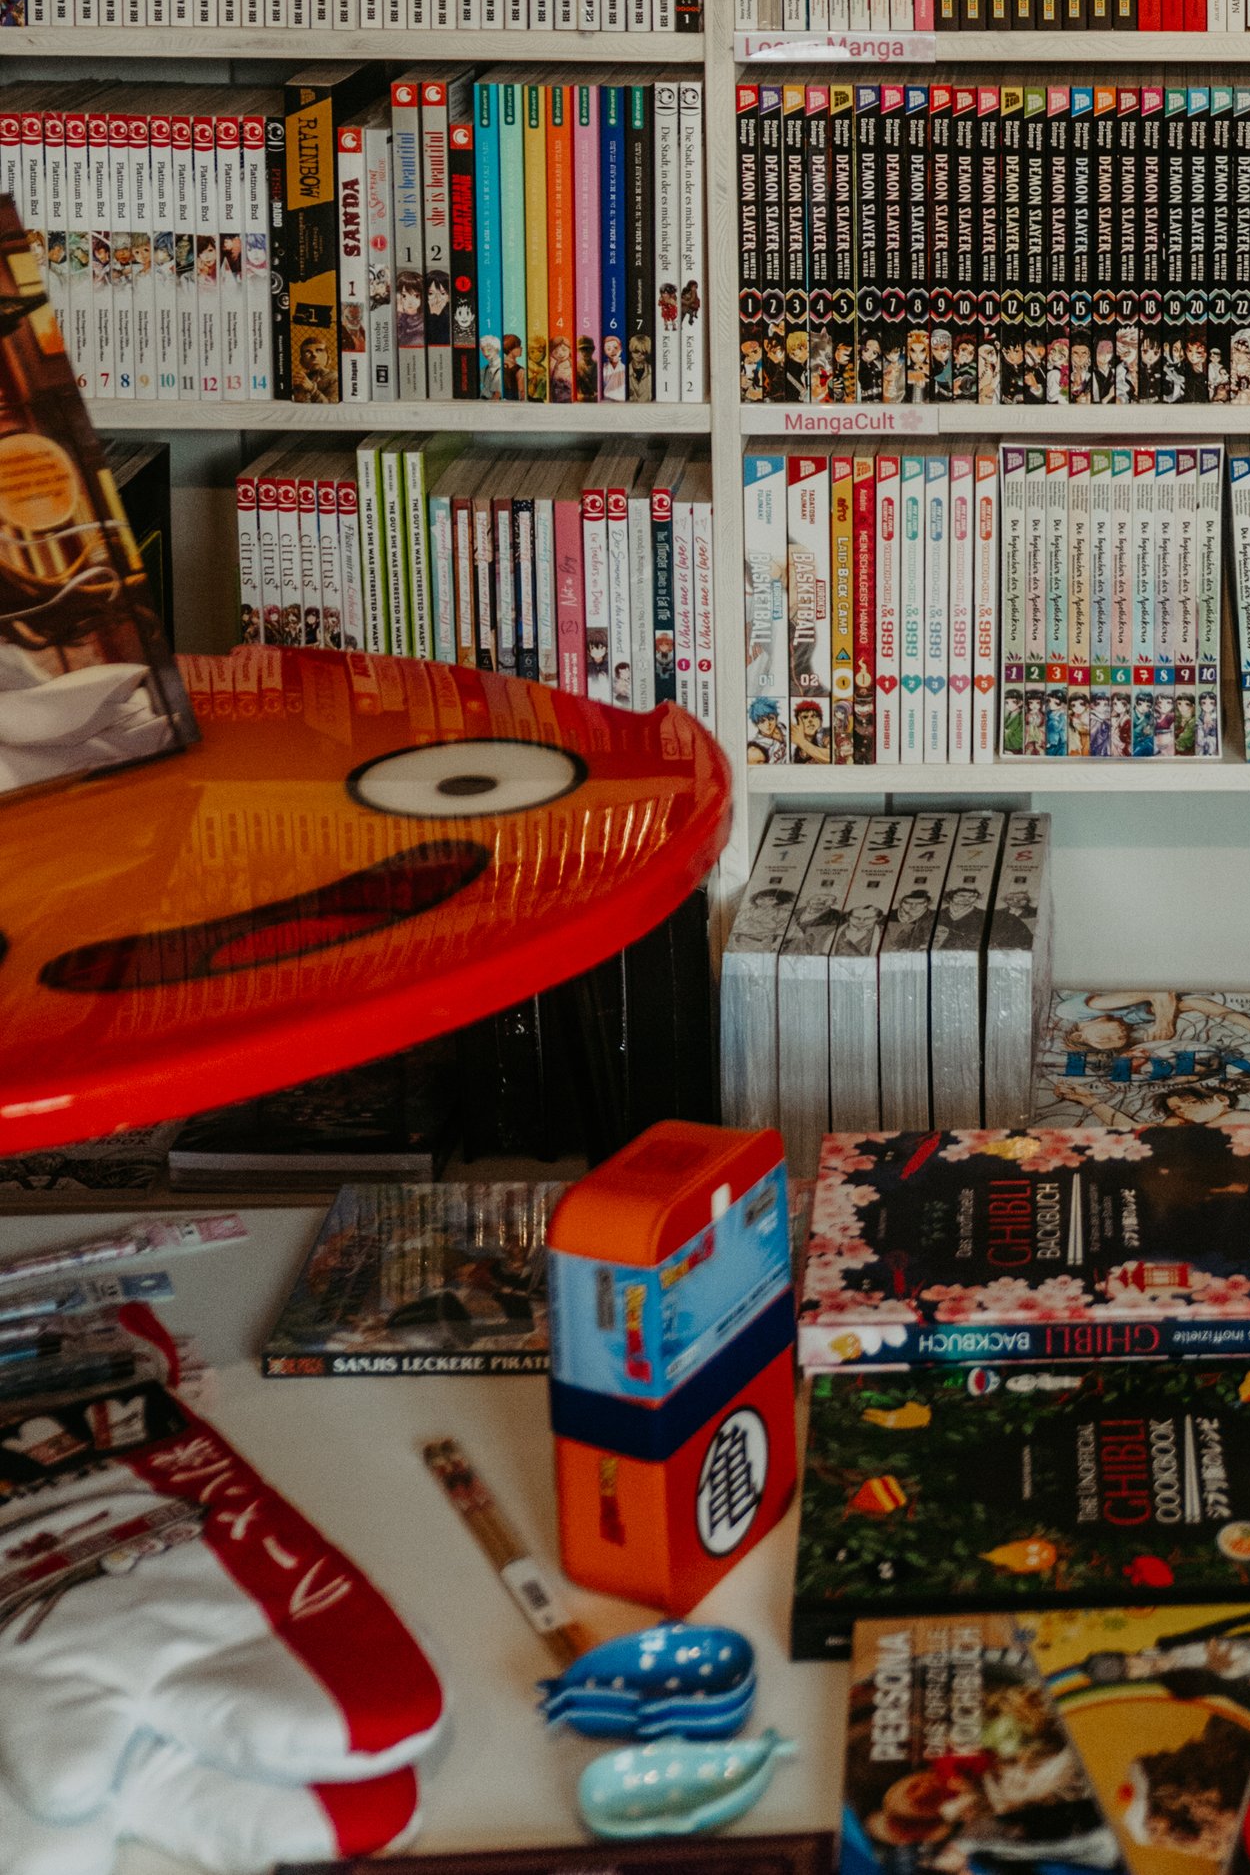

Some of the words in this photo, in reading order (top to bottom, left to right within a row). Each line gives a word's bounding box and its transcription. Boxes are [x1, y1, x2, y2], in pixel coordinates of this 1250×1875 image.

[298, 117, 321, 200] RAINBOW
[397, 132, 416, 188] beautiful
[862, 153, 875, 200] DEMON
[342, 178, 361, 257] SANDA
[399, 190, 416, 205] is
[399, 207, 417, 228] she
[862, 203, 875, 251] SLAYER
[866, 298, 872, 311] 6
[784, 413, 895, 434] MangaCult
[837, 537, 848, 598] LAID-BACK
[792, 552, 814, 646] BASKETBALL
[839, 603, 848, 635] CAMP
[800, 674, 818, 686] 02
[987, 1179, 1032, 1268] GHIBLI
[1036, 1183, 1061, 1260] BACKBUCH
[332, 1354, 398, 1373] SANJIS
[402, 1355, 485, 1372] LECKERE
